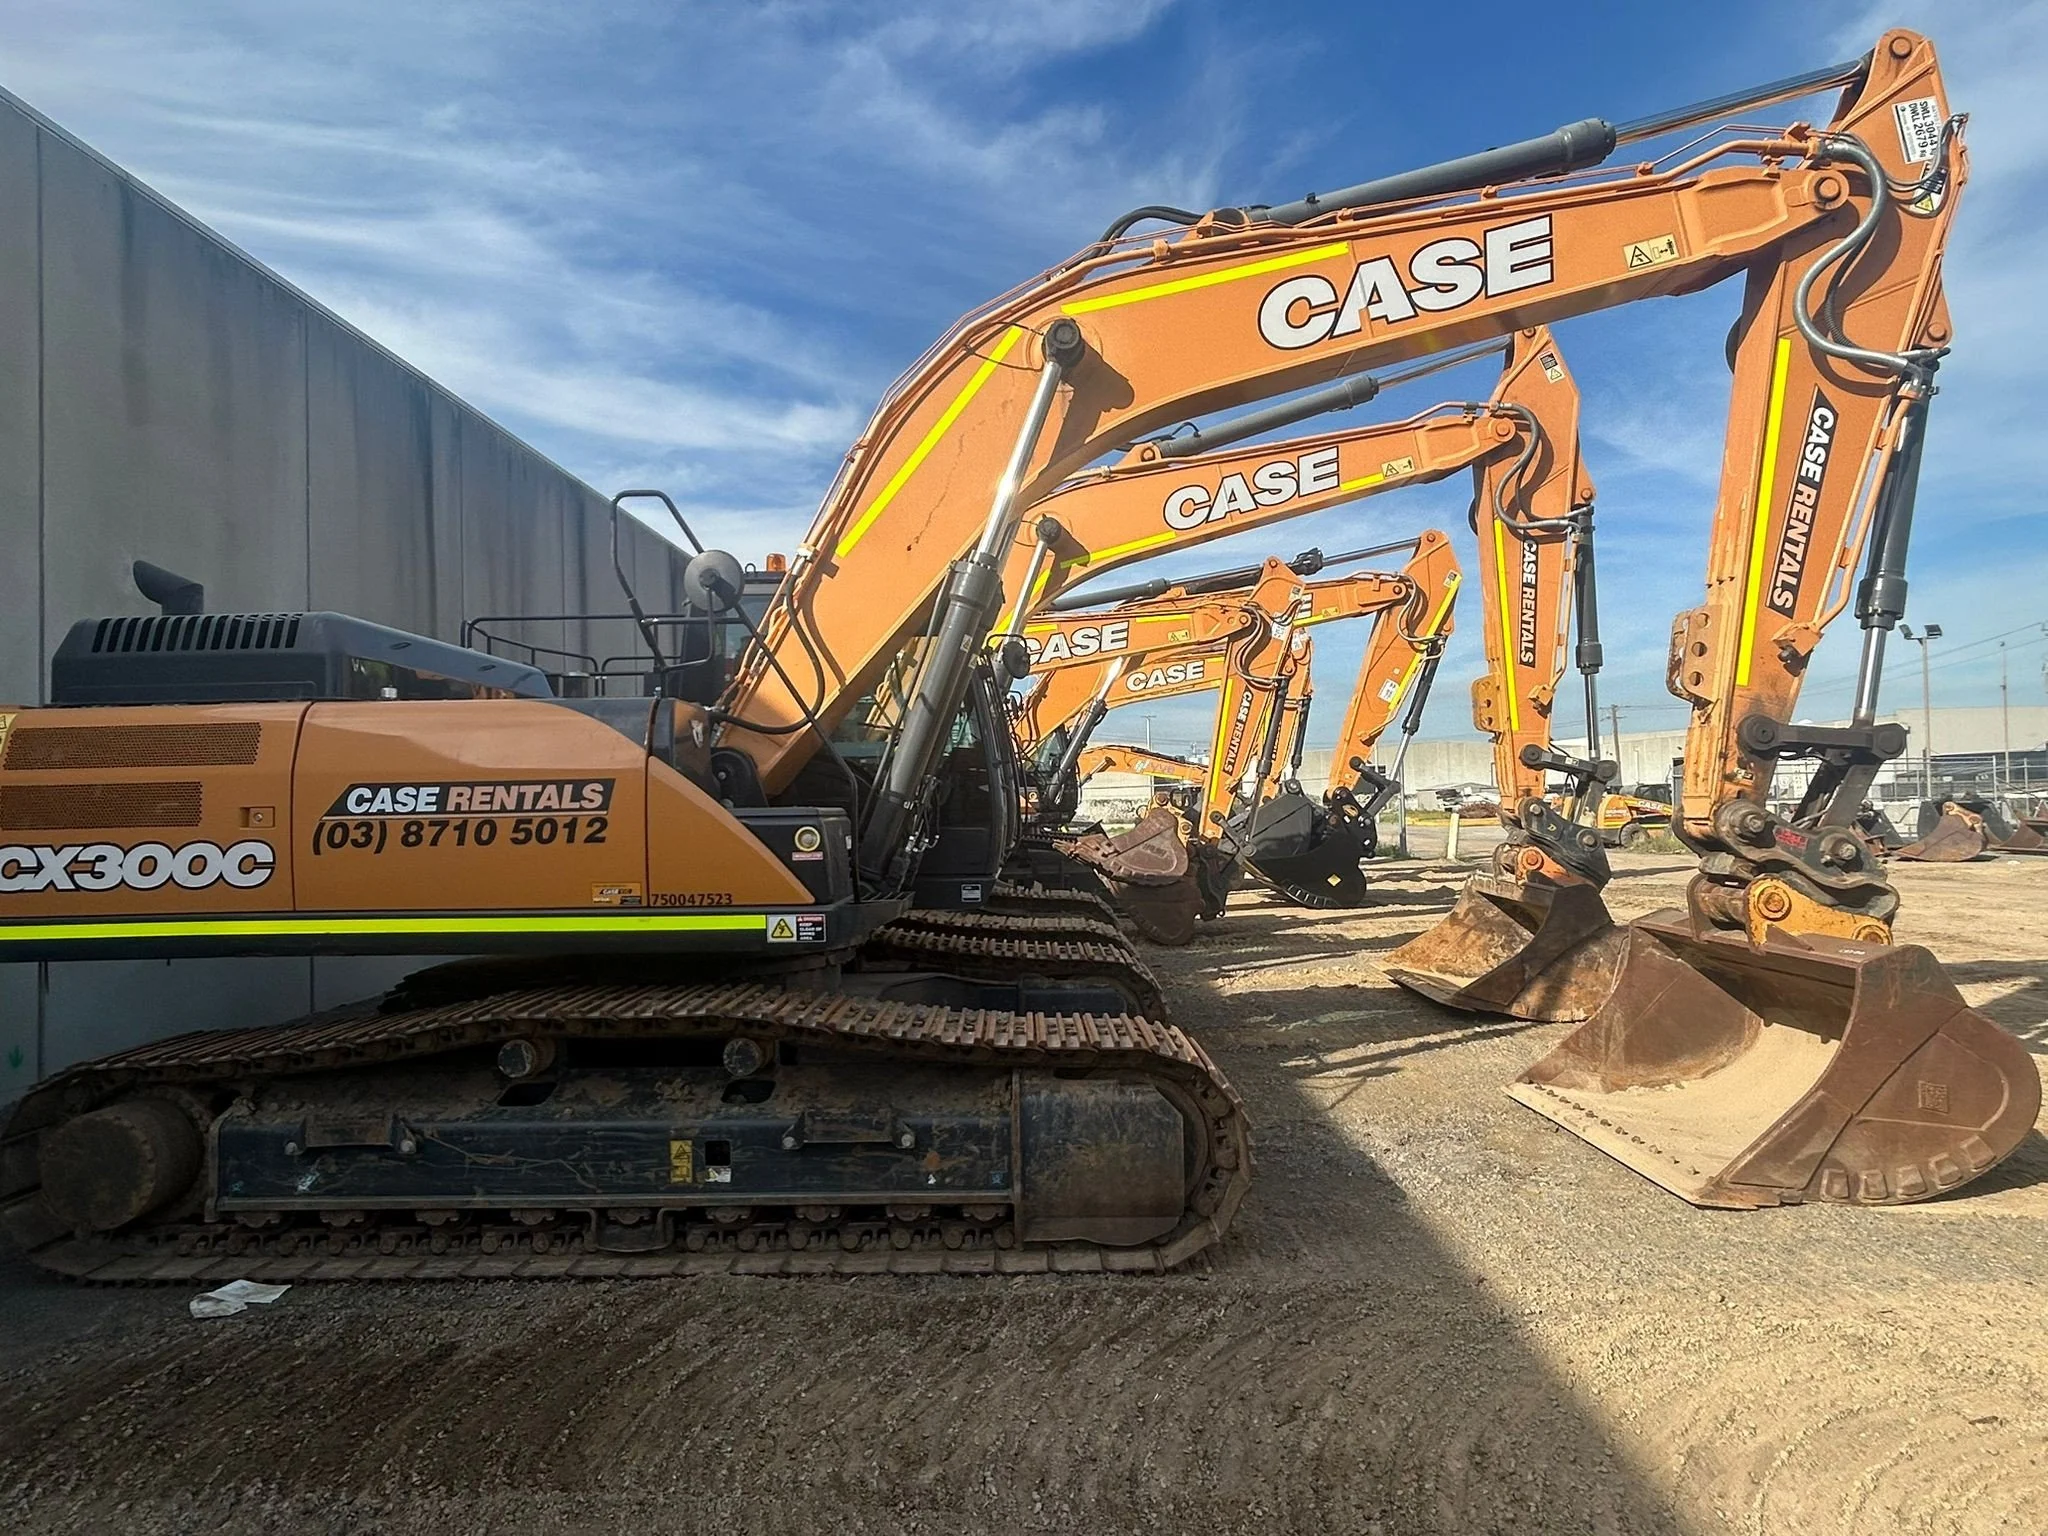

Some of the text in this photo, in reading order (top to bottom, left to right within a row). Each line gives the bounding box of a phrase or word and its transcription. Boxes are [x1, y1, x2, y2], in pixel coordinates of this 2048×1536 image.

[1924, 121, 1938, 146] 3044
[1258, 213, 1554, 350] CASE
[1163, 446, 1339, 530] CASE
[1773, 406, 1834, 609] CASE RENTALS
[1520, 539, 1537, 664] CASE RENTALS
[1126, 660, 1205, 692] CASE
[1224, 691, 1253, 773] CASE RENTALS
[346, 782, 604, 813] CASE RENTALS
[312, 817, 608, 855] (03) 8710 5012
[0, 840, 276, 892] CX300C
[651, 893, 732, 906] 750047523
